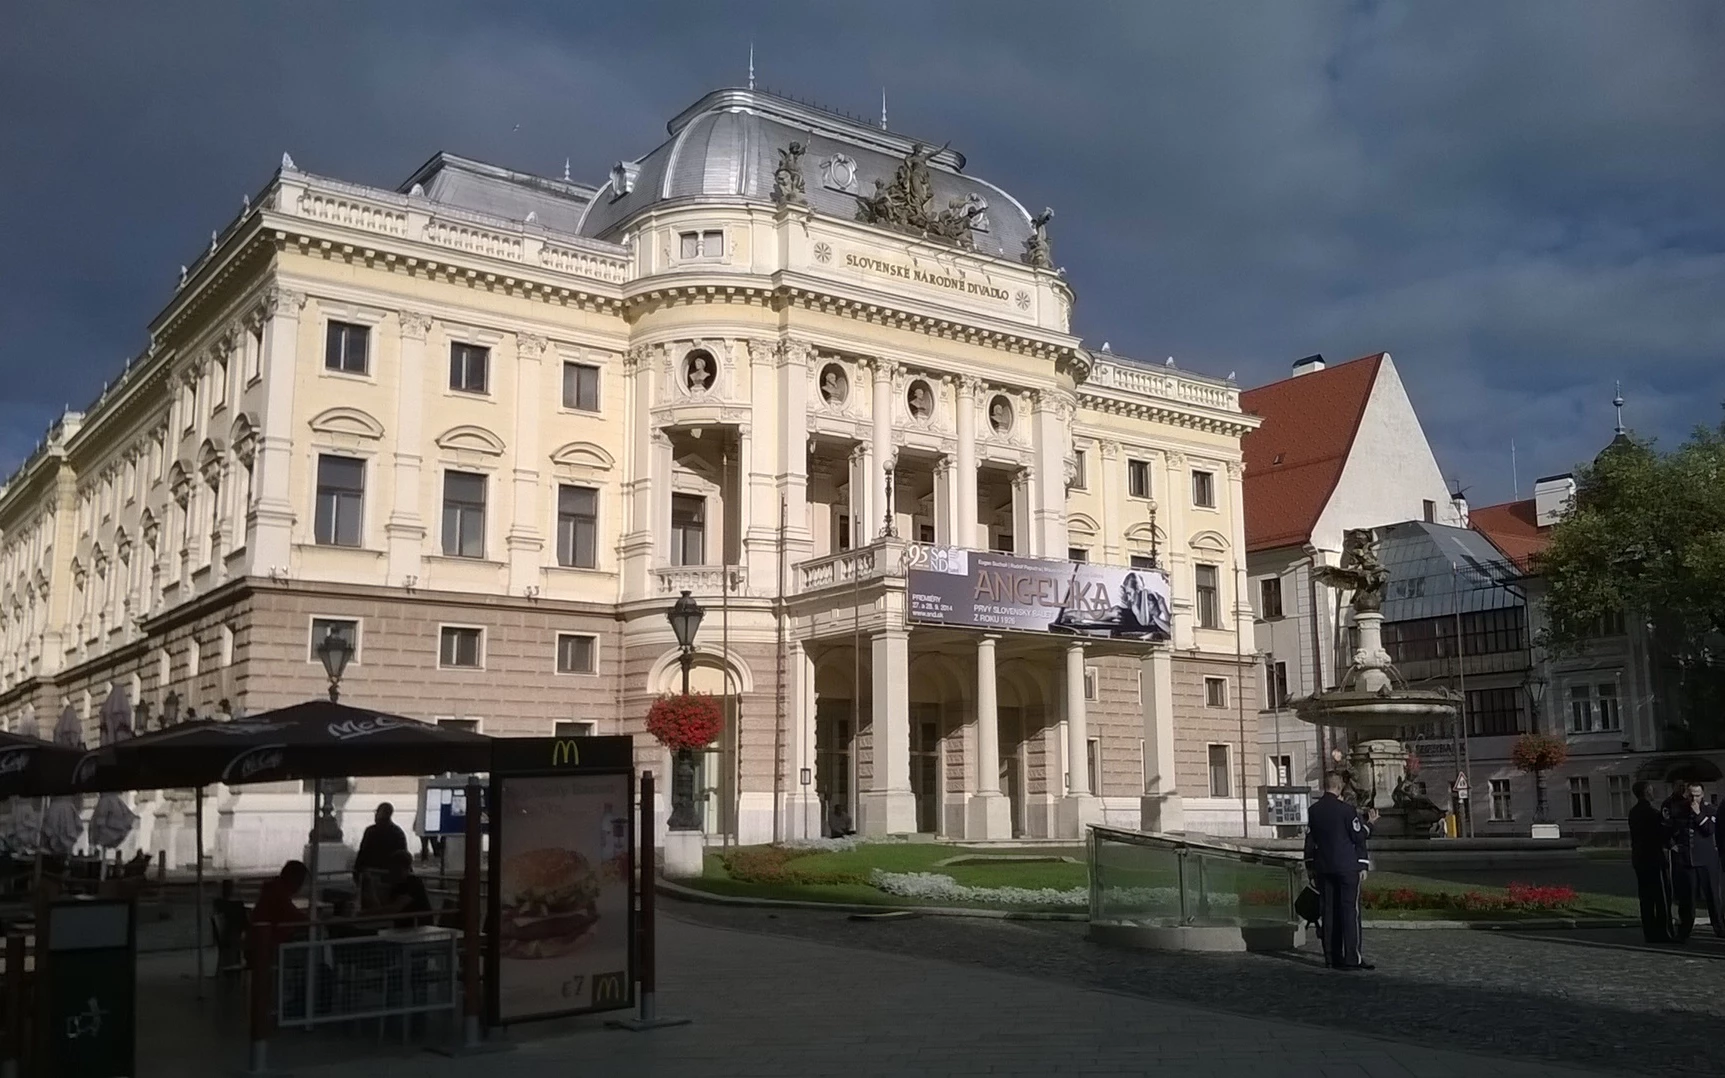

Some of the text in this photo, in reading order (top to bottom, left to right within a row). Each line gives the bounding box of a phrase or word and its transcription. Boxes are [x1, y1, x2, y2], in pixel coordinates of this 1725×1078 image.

[846, 253, 1010, 301] SLOVENSKÉ NÁRODNÉ DIVADLO
[909, 544, 930, 567] 95
[974, 570, 1112, 620] ANGELIKA
[973, 603, 992, 612] PRVÝ
[973, 614, 979, 622] Z
[980, 614, 1000, 623] ROKU
